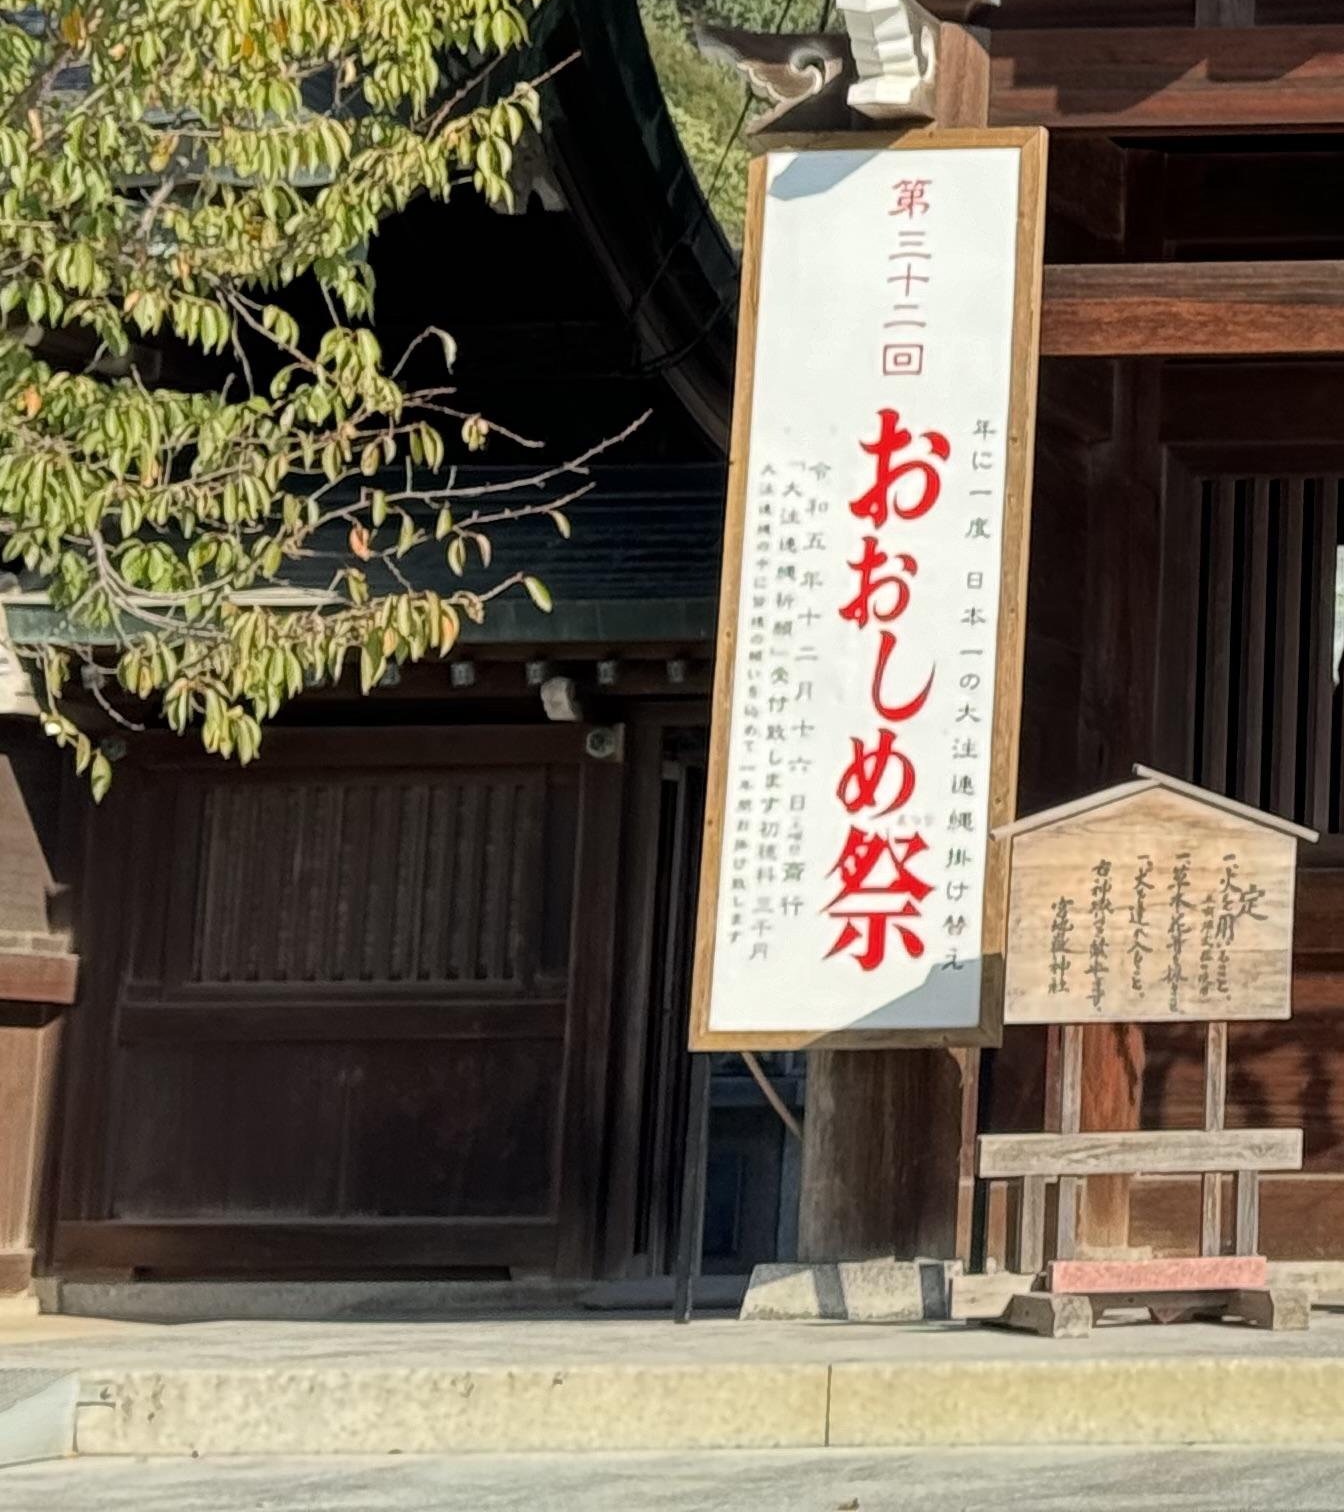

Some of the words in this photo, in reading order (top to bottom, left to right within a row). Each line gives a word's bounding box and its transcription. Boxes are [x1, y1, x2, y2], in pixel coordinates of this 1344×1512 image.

[883, 179, 932, 376] 第三十二回
[820, 408, 950, 972] おおしめ祭
[1235, 884, 1269, 921] 定
